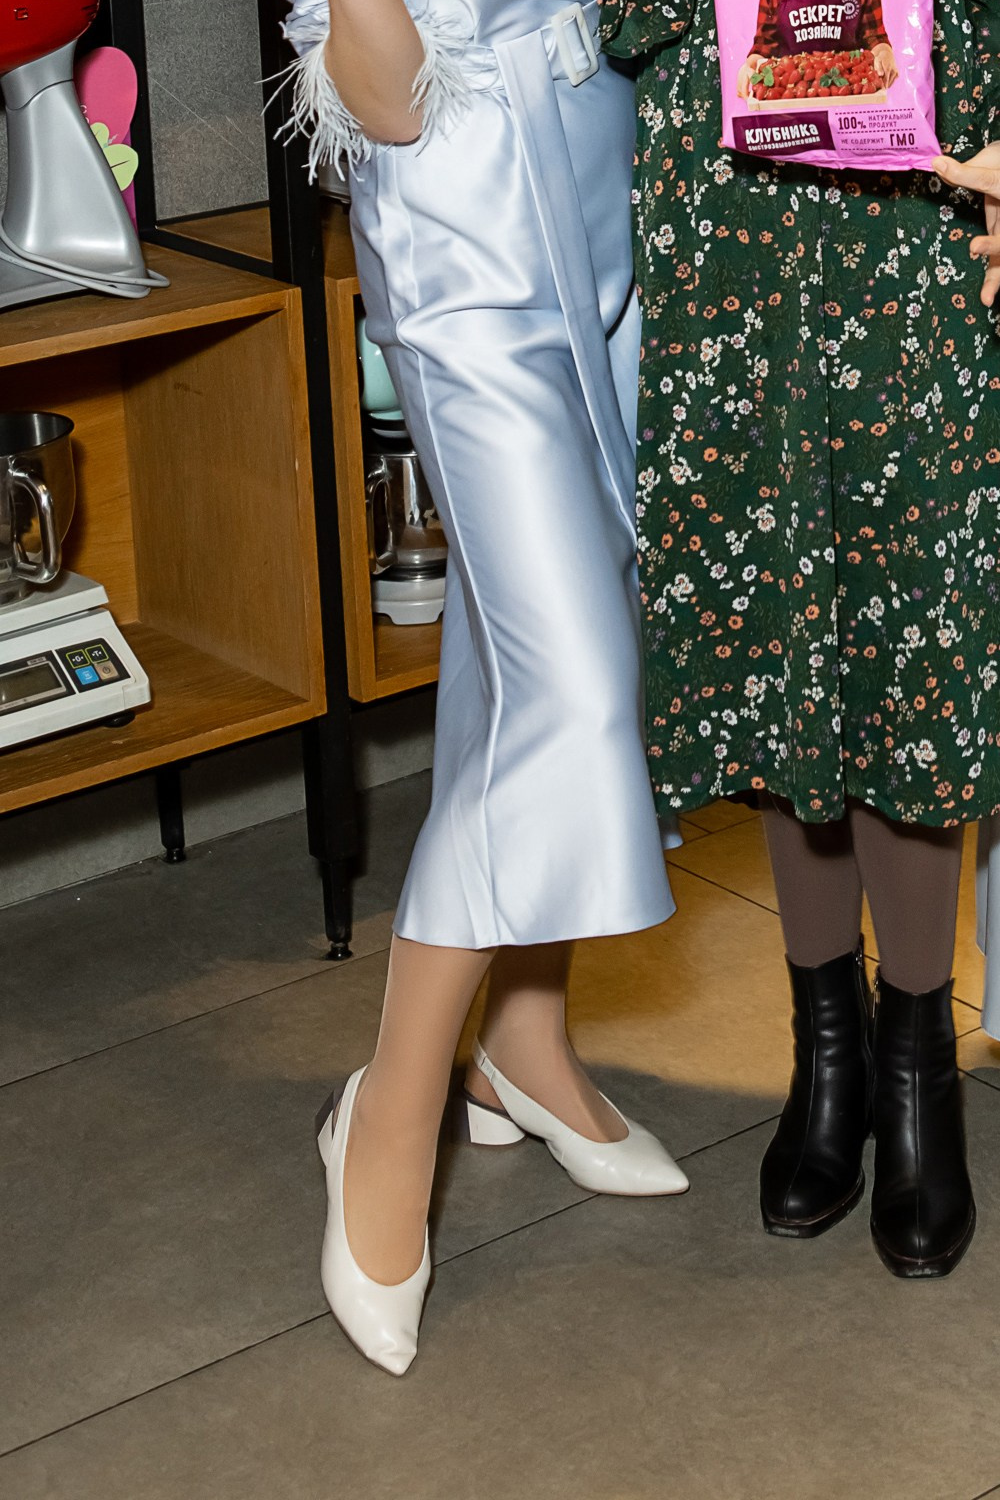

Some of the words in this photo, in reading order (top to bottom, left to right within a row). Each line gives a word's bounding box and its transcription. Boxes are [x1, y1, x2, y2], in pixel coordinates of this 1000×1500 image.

[788, 4, 845, 27] СЕКРЕТ
[794, 22, 842, 43] ХОЗЯЙКИ
[868, 111, 913, 121] НАТУРАЛЬНЫЙ
[838, 116, 867, 130] 100%
[868, 121, 897, 129] ПРОДУКТ
[850, 137, 884, 145] СОДЕРЖИТ
[889, 133, 915, 146] ГМО
